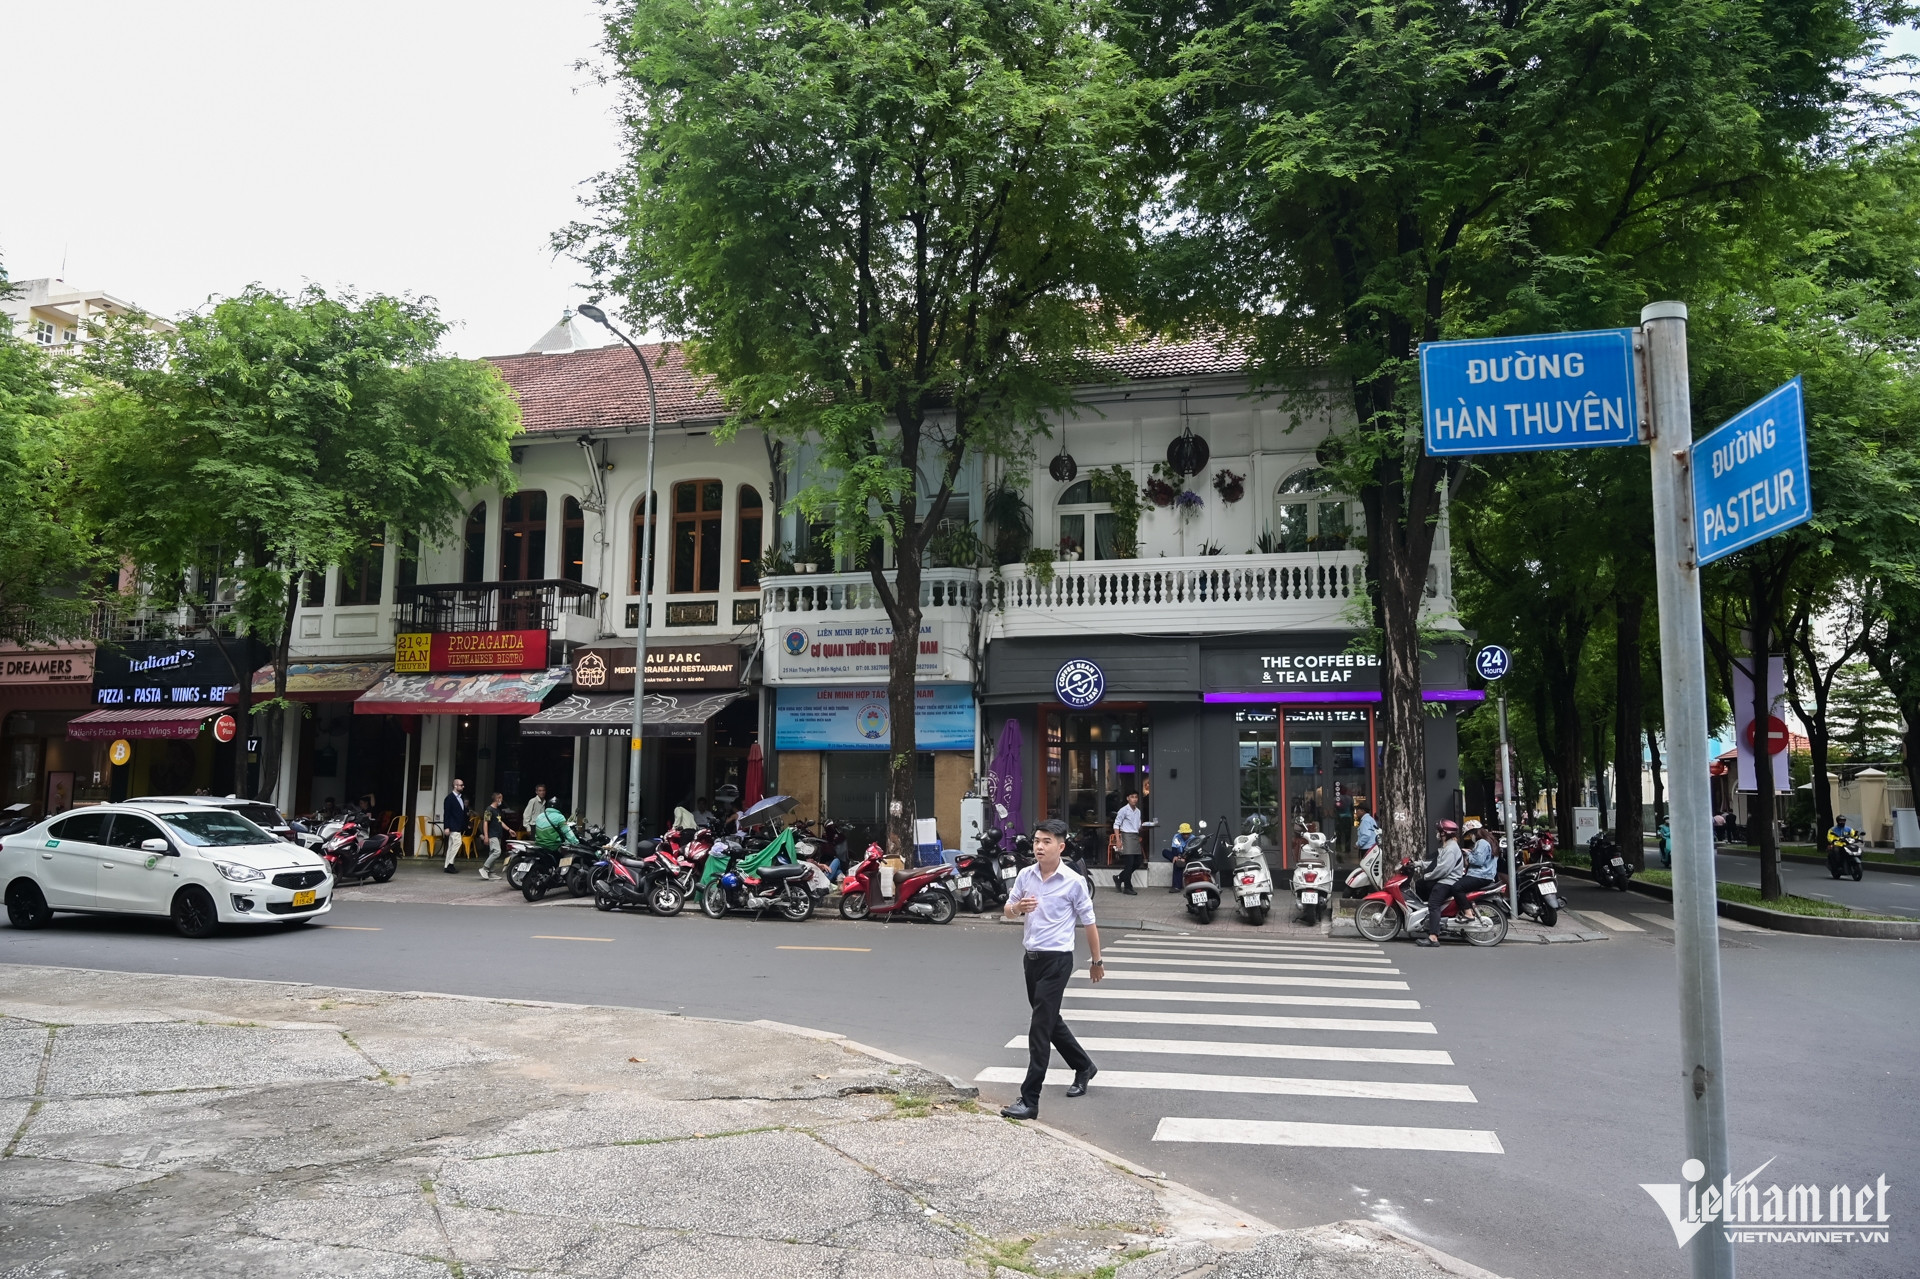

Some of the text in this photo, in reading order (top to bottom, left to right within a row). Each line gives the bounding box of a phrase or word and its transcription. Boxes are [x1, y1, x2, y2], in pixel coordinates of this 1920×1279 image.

[1466, 350, 1585, 384] ĐƯỜNG
[1435, 391, 1625, 440] HÀN THUYÊN
[1711, 418, 1776, 479] ĐƯỜNG
[1703, 467, 1797, 545] PASTEUR
[817, 628, 832, 637] LIÊN
[834, 628, 853, 636] MINH
[855, 627, 869, 637] HỢP
[919, 626, 932, 634] AM
[398, 636, 429, 649] 21 Q.1
[448, 634, 524, 651] PROPAGANDA
[397, 650, 429, 662] HAN
[811, 642, 822, 658] CƠ
[823, 643, 844, 659] QUAN
[920, 640, 938, 655] NAM
[129, 649, 195, 673] Italiani's
[448, 653, 524, 665] VIETNAMESE BISTRO
[646, 652, 701, 664] AU PARC
[1261, 656, 1291, 669] THE
[1293, 654, 1354, 668] COFFEE
[1481, 650, 1503, 668] 24
[7, 659, 73, 675] DREAMERS
[397, 662, 428, 670] THUYEN
[614, 664, 734, 674] MEDITRRANEAN RESTAURANT
[1483, 667, 1503, 675] Hours
[1059, 662, 1095, 687] COFFEE BEAN
[1262, 670, 1352, 684] & TEA LEAF
[98, 688, 124, 703] PIZZA
[134, 687, 161, 702] PASTA
[171, 686, 200, 702] WINGS
[817, 689, 833, 700] LIÊN
[834, 690, 854, 699] MINH
[856, 690, 870, 700] HỢP
[916, 689, 934, 698] NAM
[1072, 687, 1099, 704] TEA LEAF
[1334, 711, 1358, 721] TEA
[68, 729, 97, 737] Italiani's
[98, 728, 116, 736] Pizza
[122, 727, 141, 735] Pasta
[148, 726, 171, 737] Wings
[177, 726, 198, 735] Beers
[589, 728, 631, 736] AU PARC
[890, 802, 900, 811] 23
[1394, 811, 1405, 821] 25
